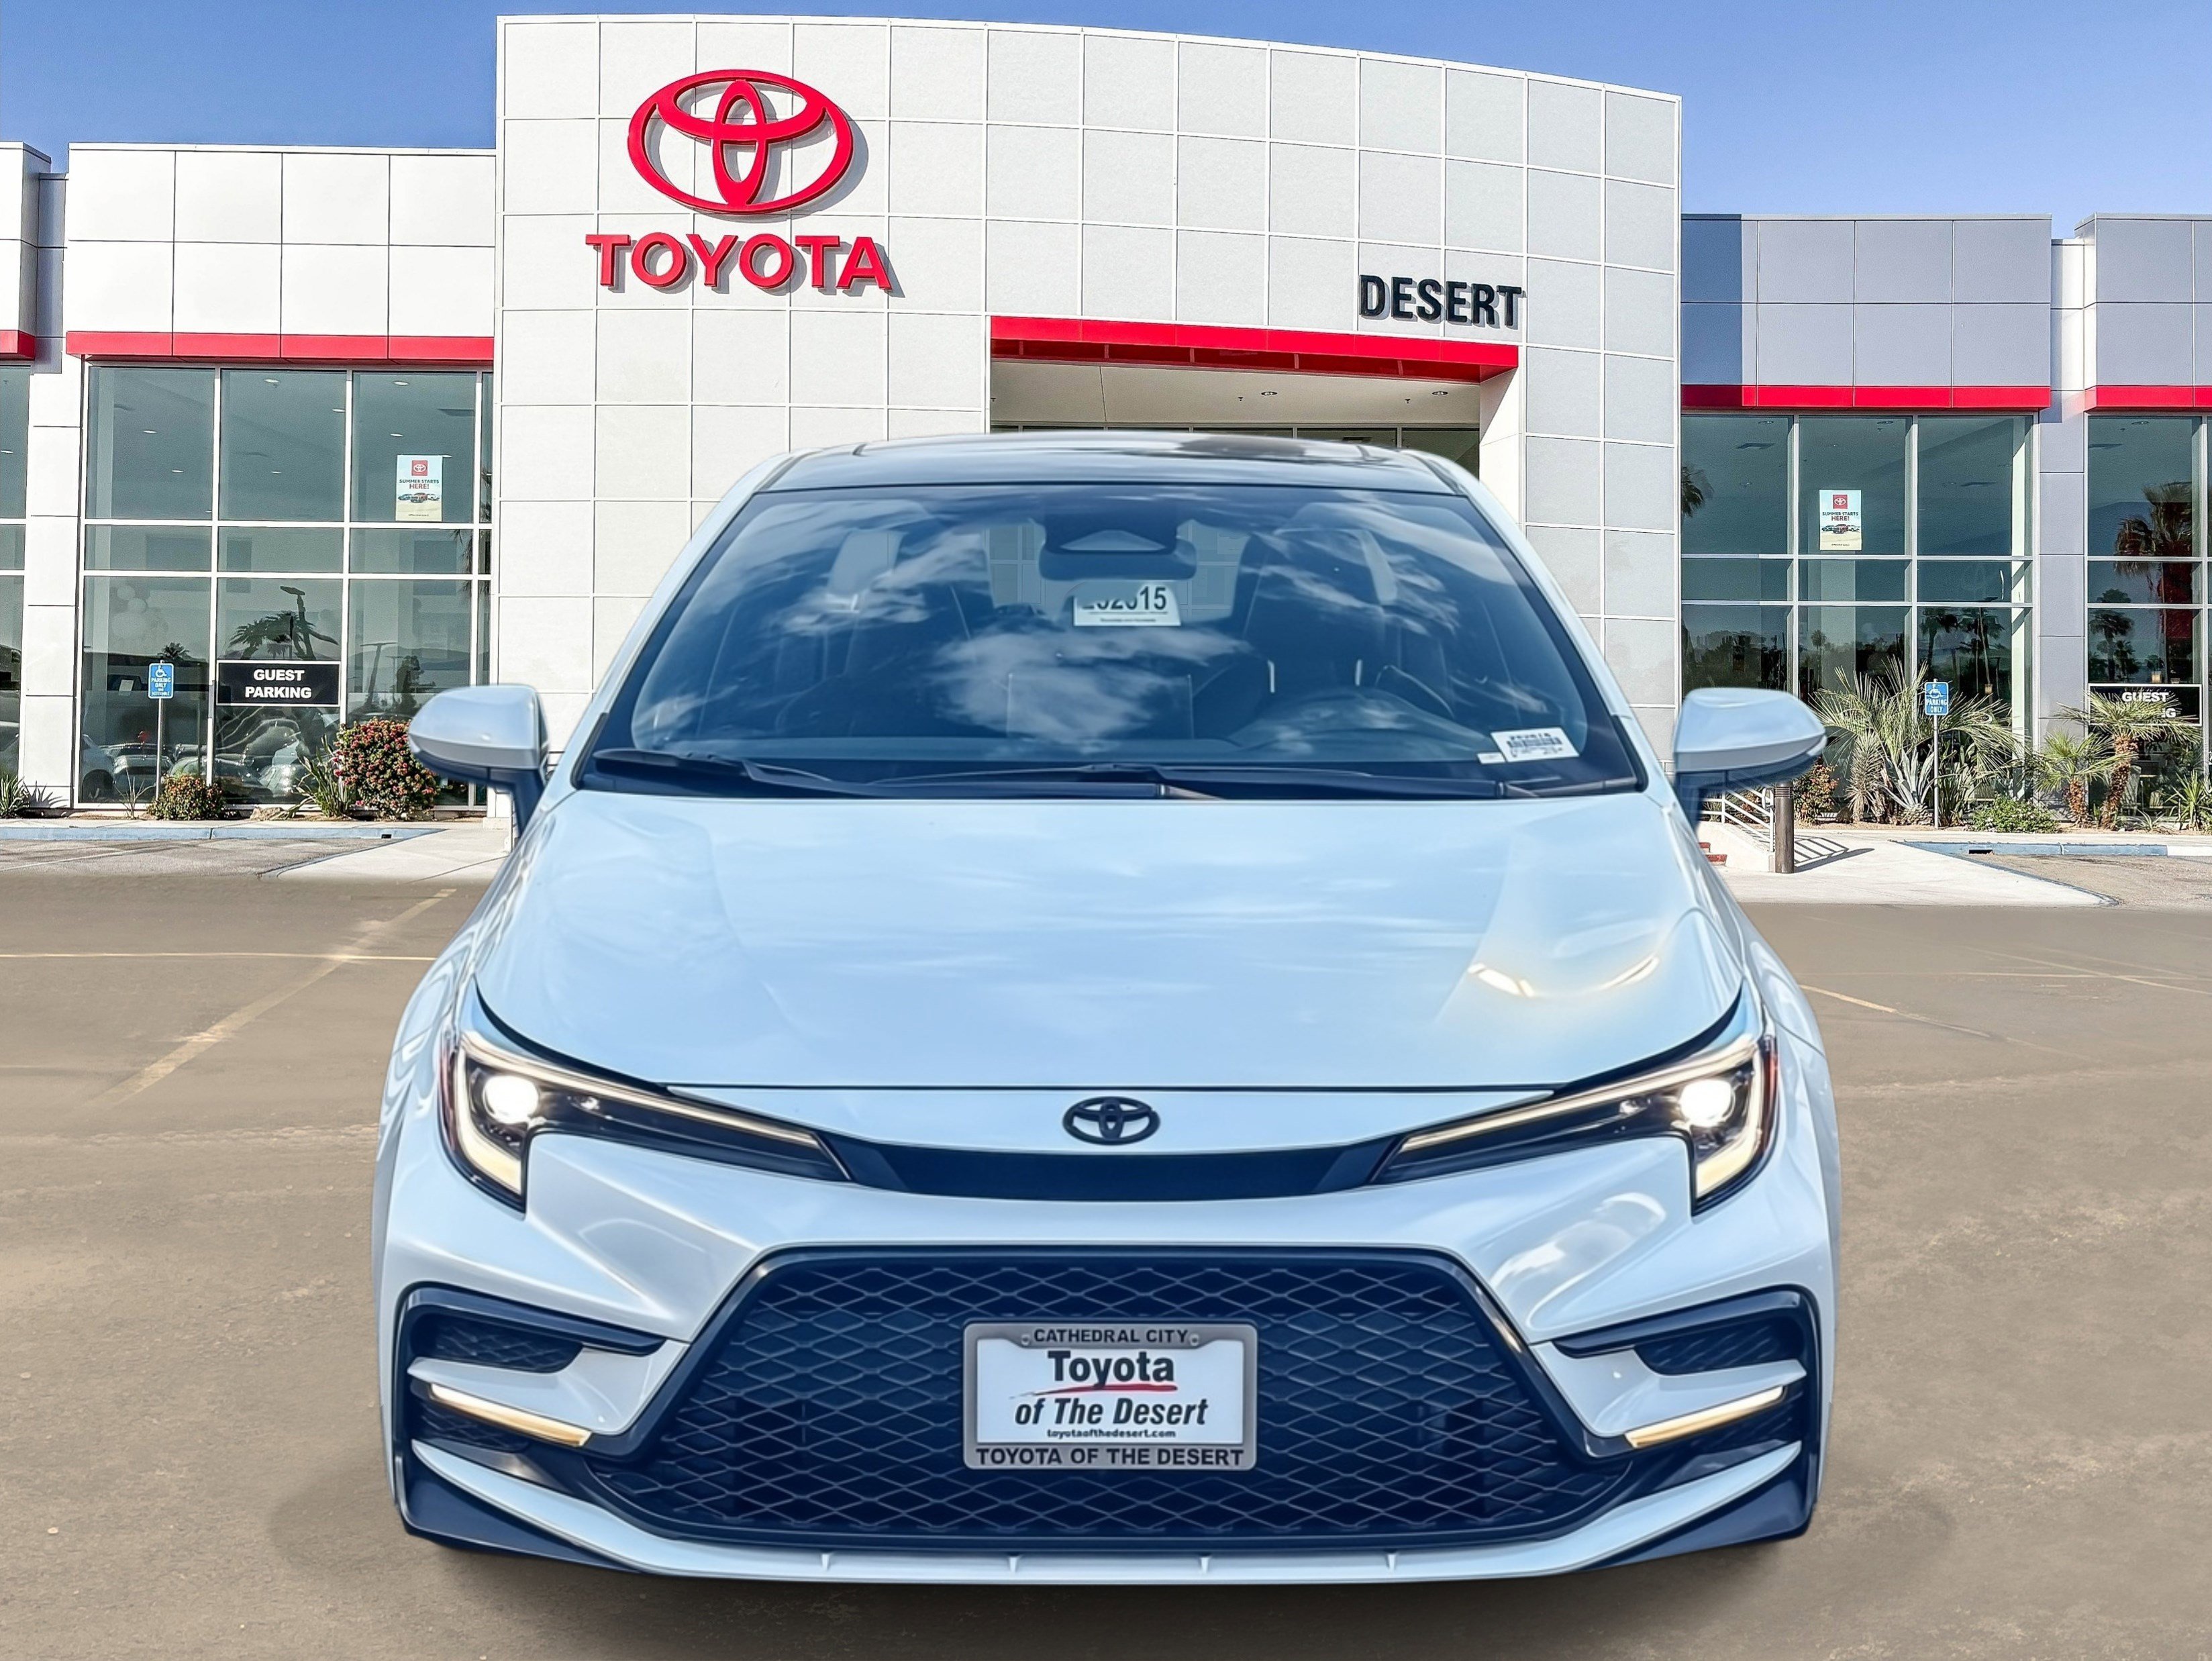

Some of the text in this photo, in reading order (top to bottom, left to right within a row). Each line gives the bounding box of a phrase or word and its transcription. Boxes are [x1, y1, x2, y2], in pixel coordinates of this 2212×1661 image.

[585, 232, 893, 290] TOYOTA
[1359, 274, 1523, 327] DESERT
[253, 669, 305, 681] GUEST
[245, 686, 312, 699] PARKING
[2121, 692, 2169, 702] GUEST
[1034, 1329, 1189, 1343] CATHEDRAL CITY
[1048, 1350, 1174, 1389] Toyota
[1015, 1398, 1209, 1425] of The Desert
[1047, 1428, 1176, 1439] toyotaofthedesert.com
[976, 1448, 1244, 1465] TOYOTA OF THE DESERT
